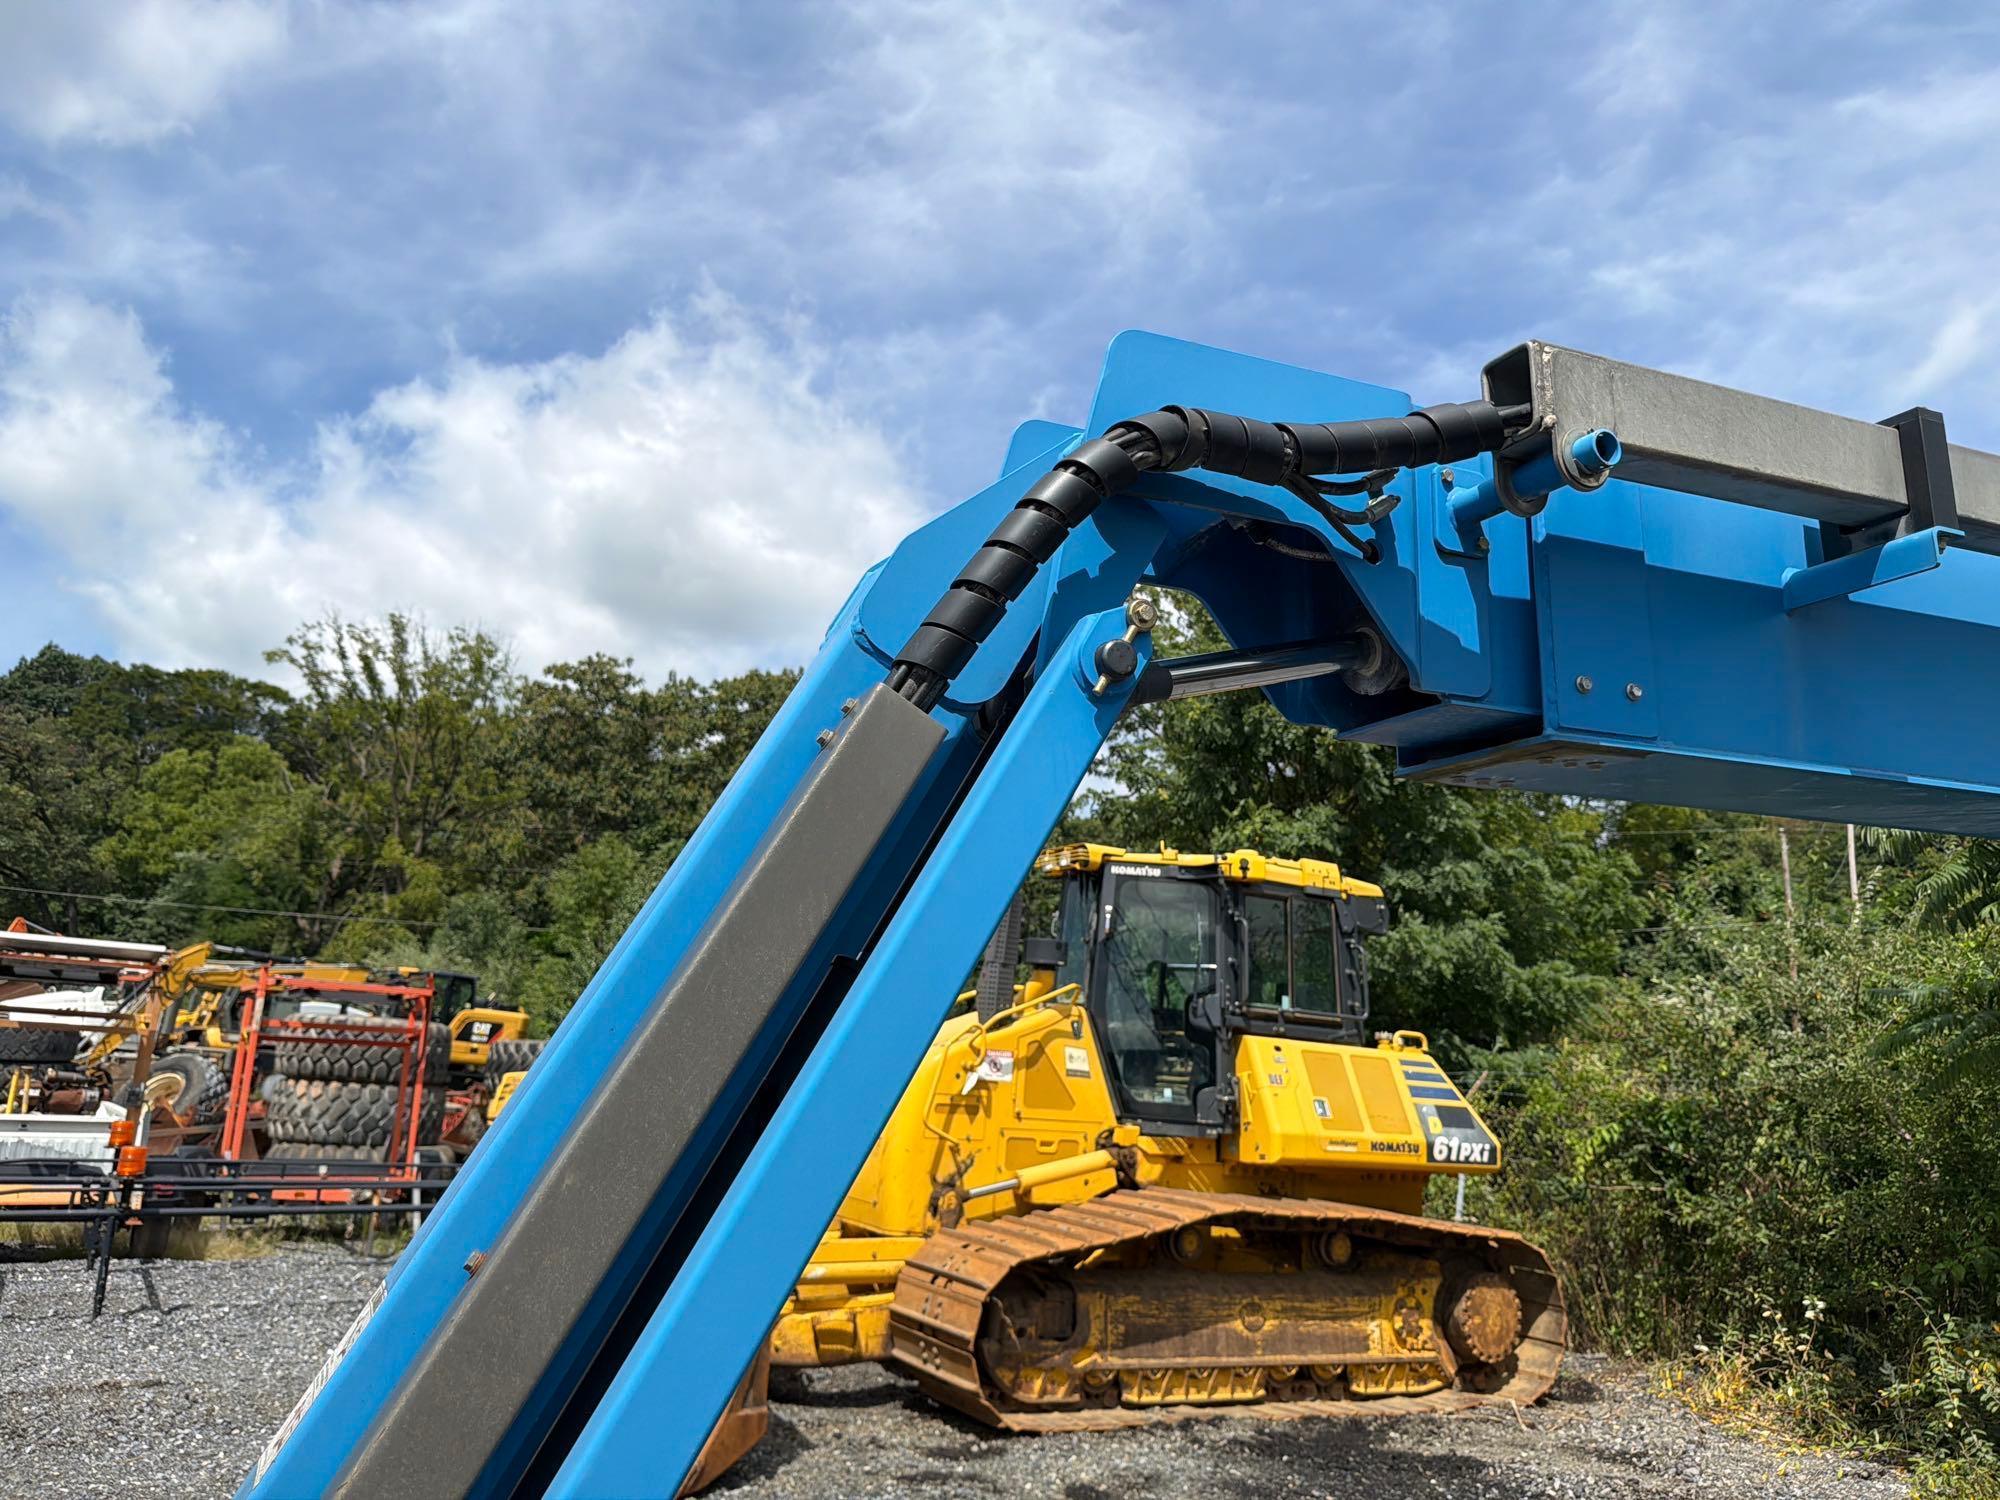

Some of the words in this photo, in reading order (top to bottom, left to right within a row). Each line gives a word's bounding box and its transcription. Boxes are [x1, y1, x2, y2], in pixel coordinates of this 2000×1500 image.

[1111, 865, 1161, 877] KOMATSU
[1371, 1140, 1420, 1154] KOMATSU
[1433, 1135, 1490, 1163] 61PXi
